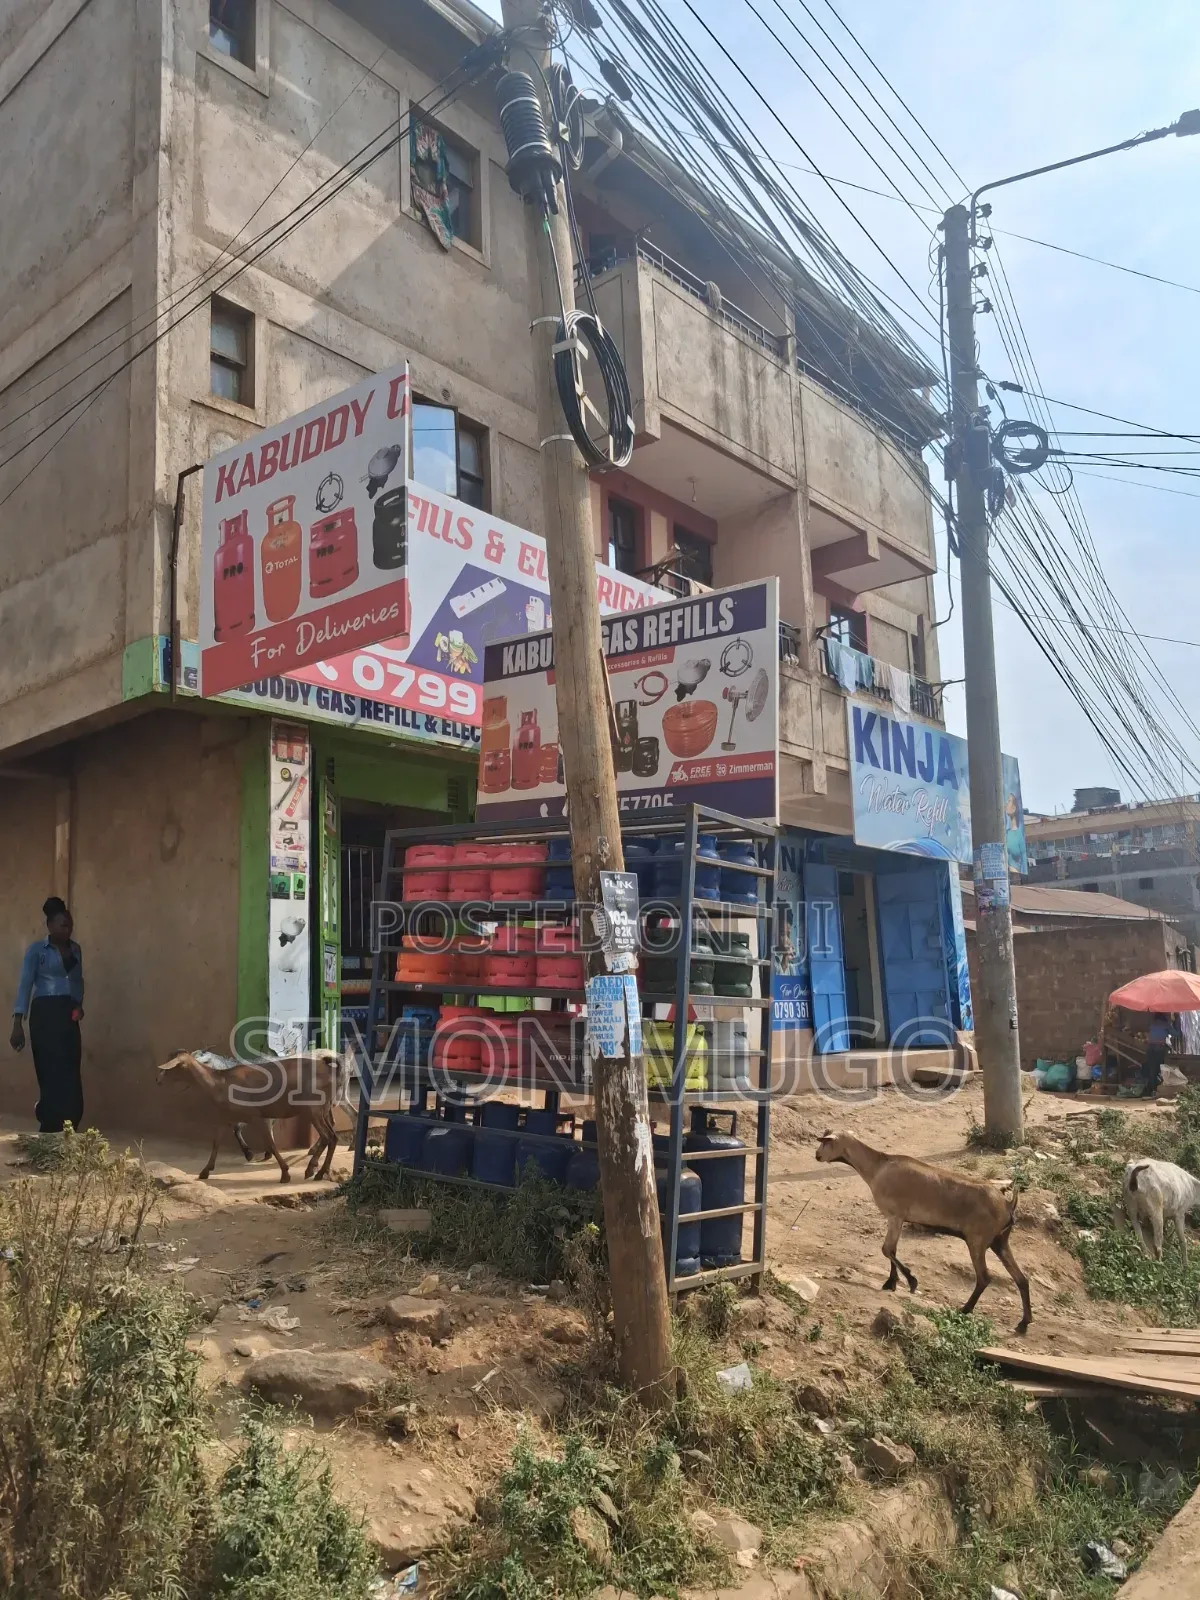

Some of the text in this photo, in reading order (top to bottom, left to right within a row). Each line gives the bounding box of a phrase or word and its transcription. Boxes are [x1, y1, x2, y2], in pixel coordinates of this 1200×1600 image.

[214, 389, 375, 504] KABUDDY
[274, 556, 298, 570] TOTAL
[484, 529, 506, 564] &
[251, 600, 399, 668] For Deliveries
[643, 597, 734, 649] REFILLS
[353, 654, 477, 716] 0799
[607, 653, 668, 670] ccessories & Refills
[316, 685, 357, 717] GAS
[361, 698, 421, 731] REFILL
[425, 715, 438, 734] &
[691, 763, 773, 775] FREE Zimmerman
[852, 706, 959, 791] KINJA
[860, 773, 949, 838] Water Refill
[775, 1001, 809, 1018] 0790 361
[780, 983, 792, 998] For
